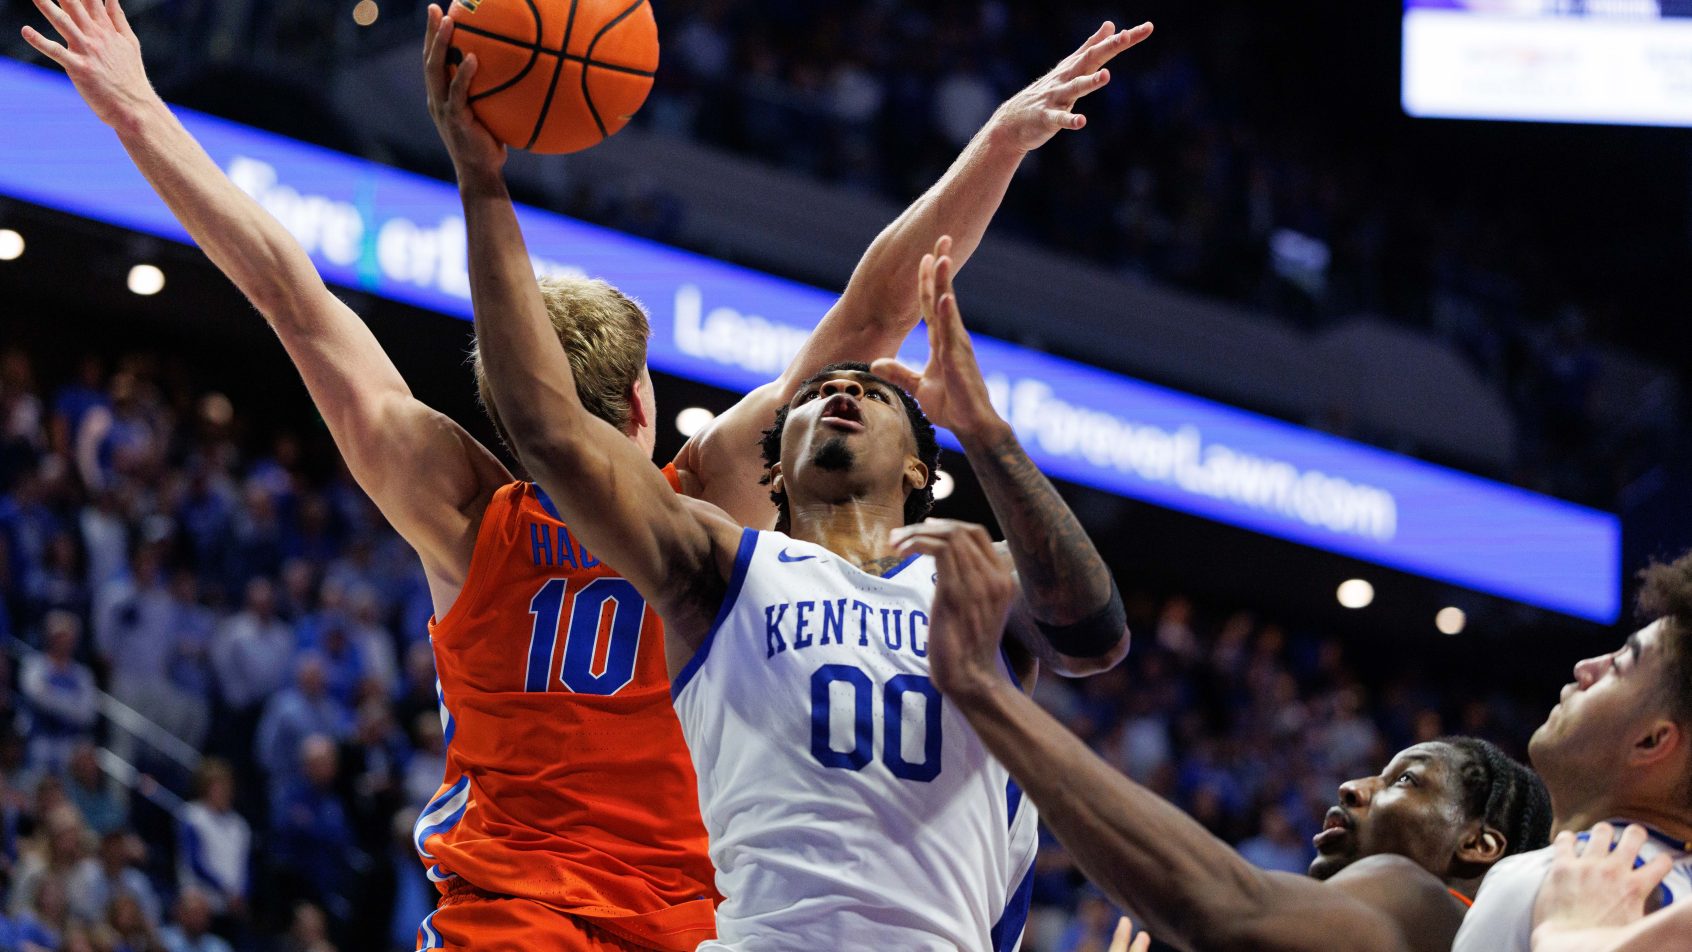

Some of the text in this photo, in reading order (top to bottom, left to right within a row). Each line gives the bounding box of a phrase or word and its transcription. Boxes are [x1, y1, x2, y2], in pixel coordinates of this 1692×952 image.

[524, 577, 646, 696] 10
[765, 598, 929, 660] KENTUC
[810, 663, 943, 783] 00
